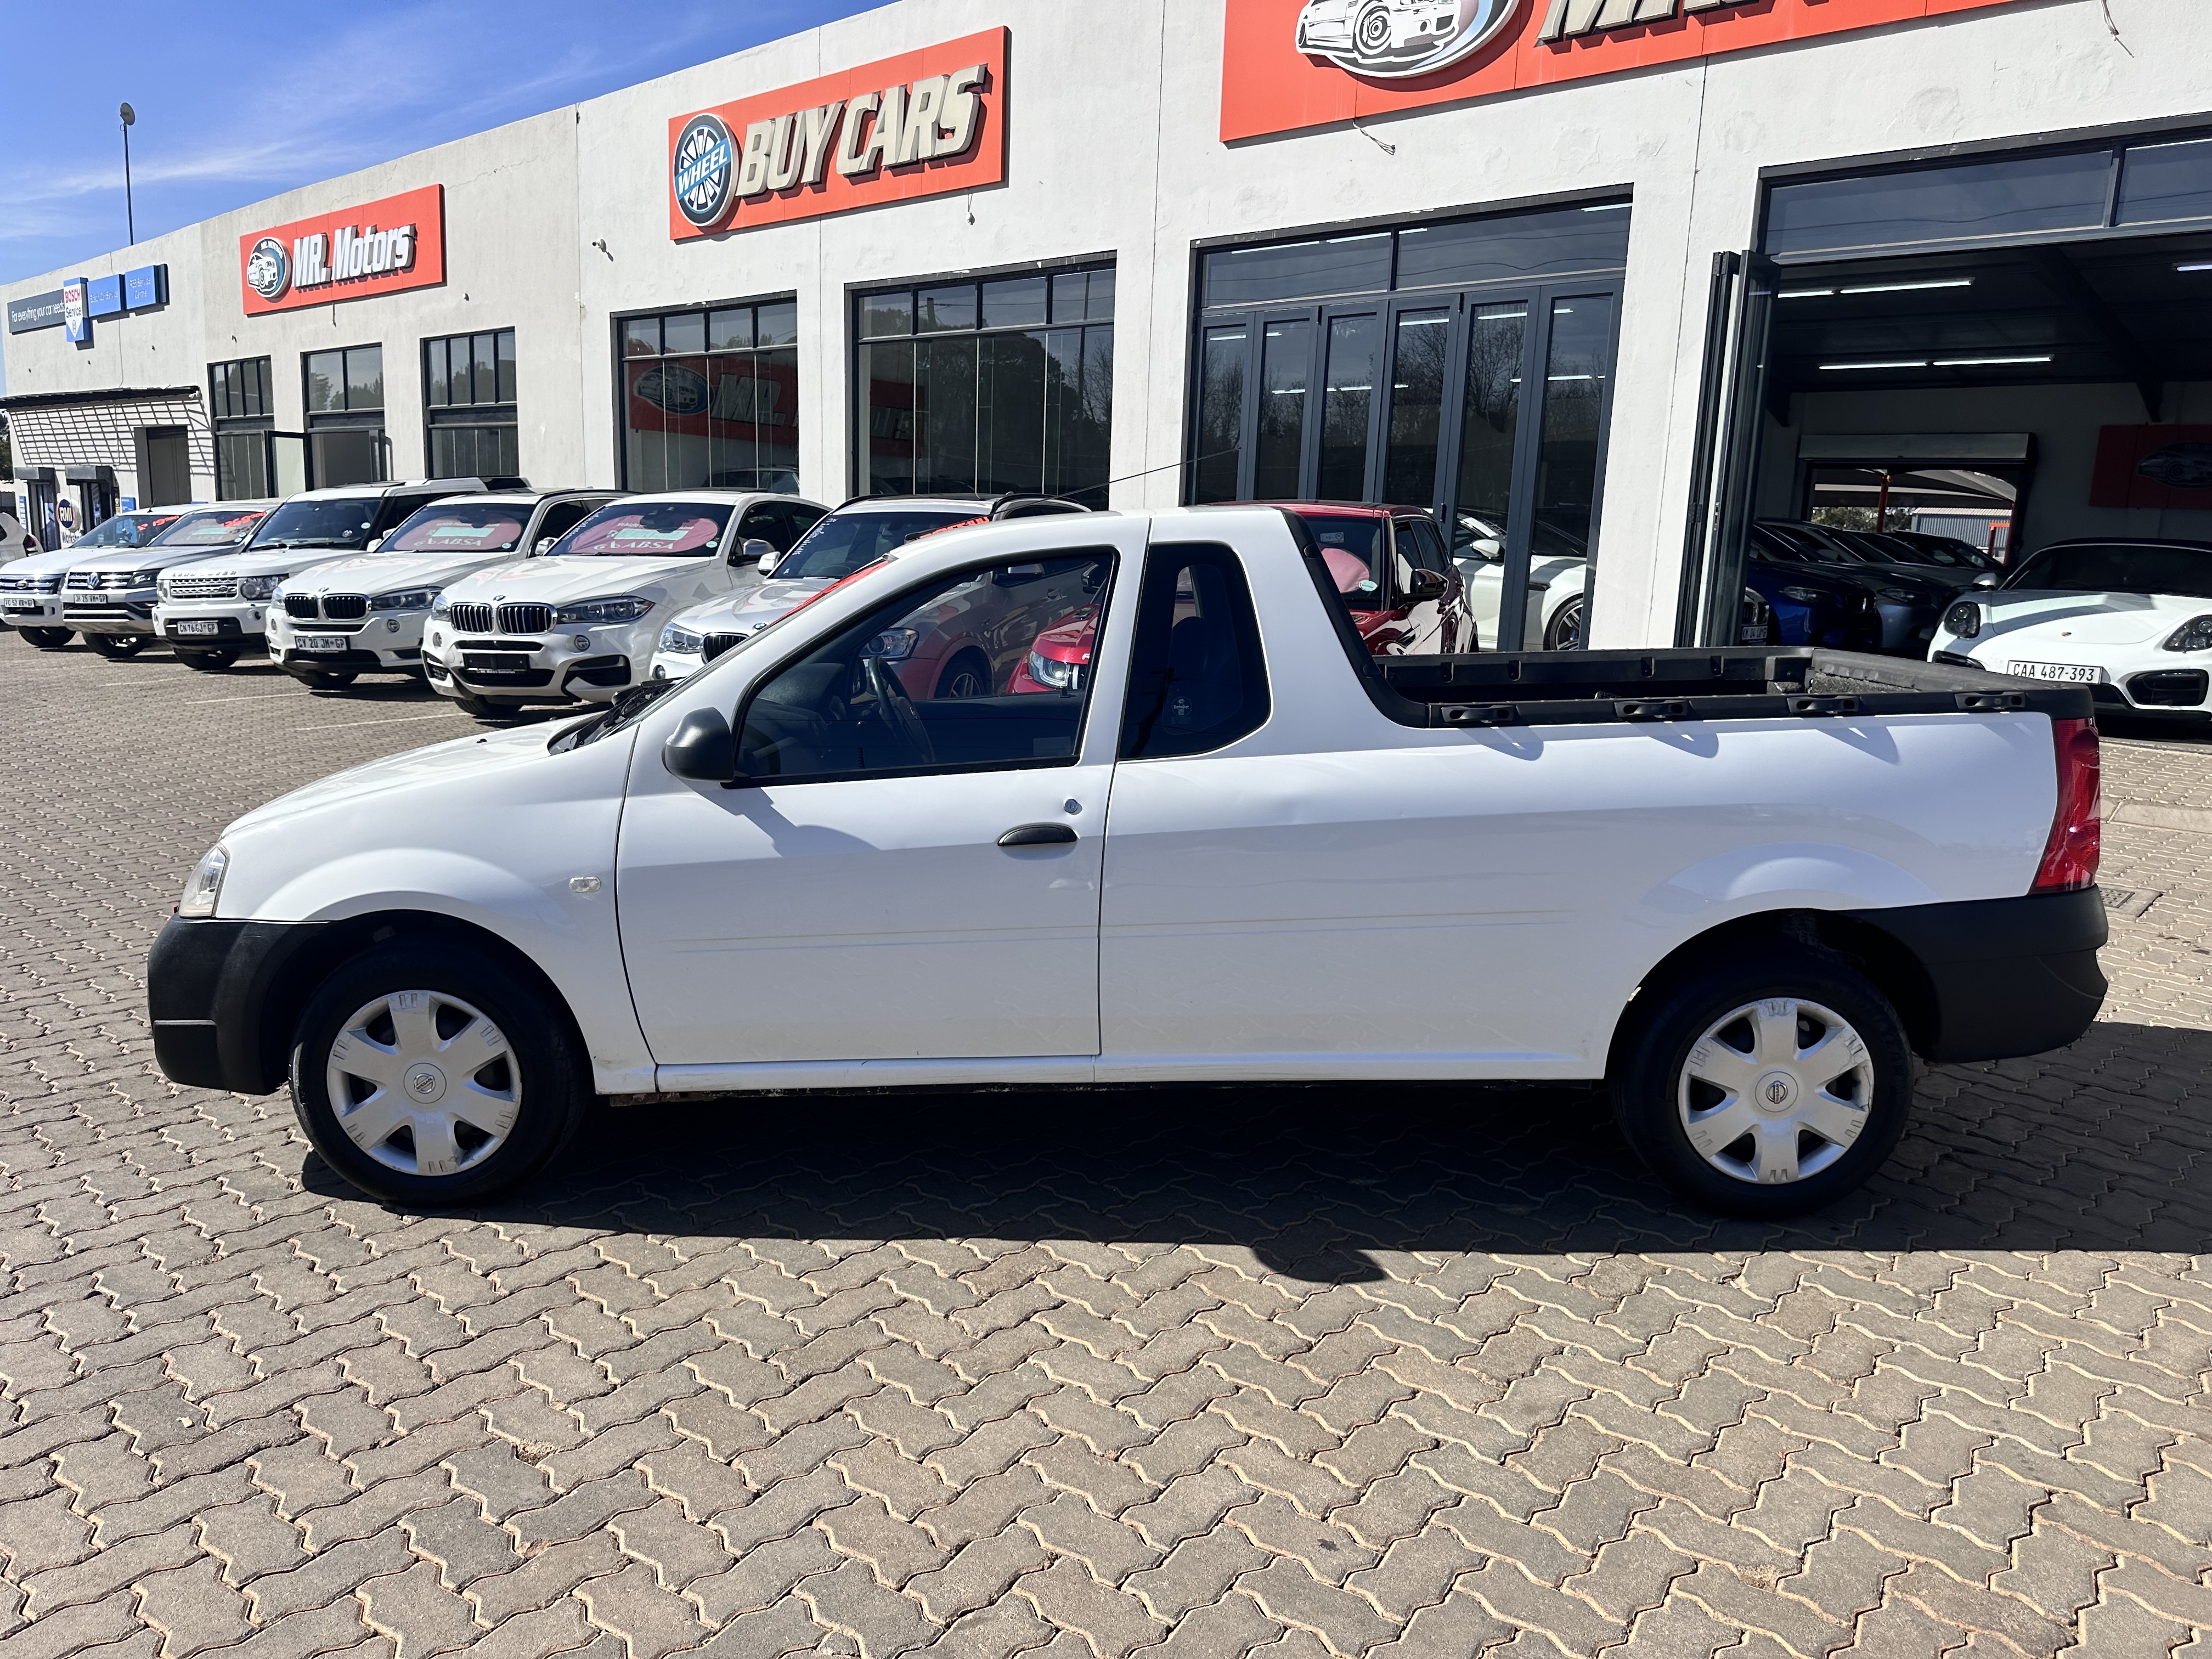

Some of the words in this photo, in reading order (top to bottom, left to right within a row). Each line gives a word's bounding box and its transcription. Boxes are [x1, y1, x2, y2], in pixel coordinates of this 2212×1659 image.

[735, 100, 847, 198] BUY
[837, 63, 991, 178] CARS
[679, 144, 727, 195] WHEEL
[292, 233, 331, 288] MR.
[331, 223, 416, 280] Motors
[65, 287, 81, 303] BOSCH
[18, 306, 37, 323] everything
[37, 307, 46, 320] your
[66, 306, 82, 318] Service
[59, 506, 72, 522] RMI
[438, 537, 481, 546] ABSA
[622, 541, 674, 549] ABSA
[187, 624, 195, 633] 76
[208, 624, 215, 633] GP
[297, 638, 306, 648] CY
[309, 638, 318, 648] 20
[335, 639, 344, 648] GP
[2013, 664, 2035, 678] CAA
[2040, 665, 2095, 681] 487-393
